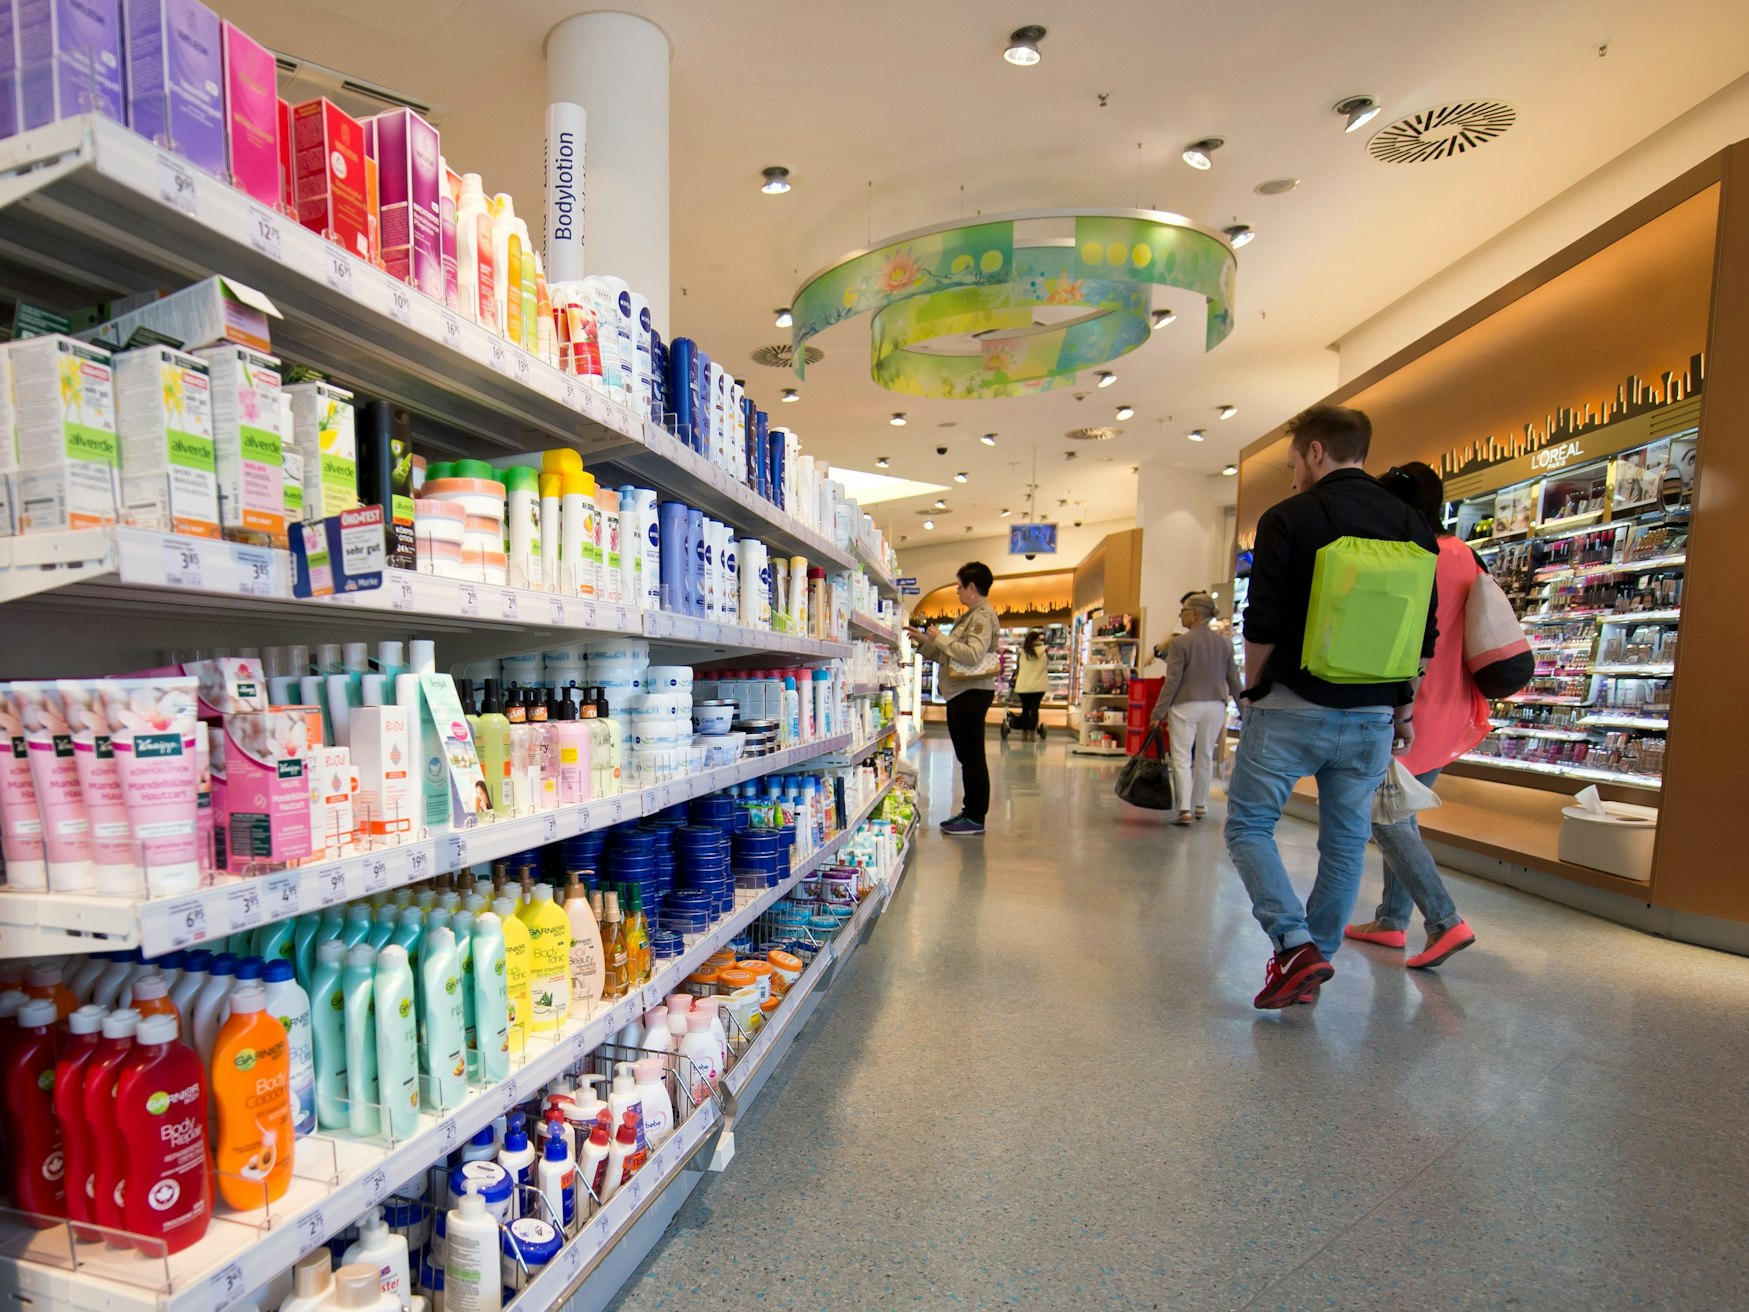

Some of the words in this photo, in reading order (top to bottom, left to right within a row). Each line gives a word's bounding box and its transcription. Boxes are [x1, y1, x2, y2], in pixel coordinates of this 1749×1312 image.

[554, 131, 576, 241] Bodylotion
[68, 432, 113, 453] alverde
[171, 438, 211, 459] alverde
[243, 434, 281, 454] alverde
[1531, 441, 1584, 470] L'ORÉAL
[1547, 459, 1567, 470] PARIS
[323, 460, 355, 479] alverde
[367, 543, 381, 556] gut
[136, 737, 182, 755] Kneipp
[528, 925, 565, 936] GARNIER
[533, 948, 559, 960] Body
[507, 964, 521, 975] ody
[234, 1041, 284, 1067] GARNIER
[256, 1071, 287, 1096] Body
[146, 1083, 199, 1109] GARNIER
[160, 1117, 195, 1141] Body
[645, 1120, 661, 1129] bebe
